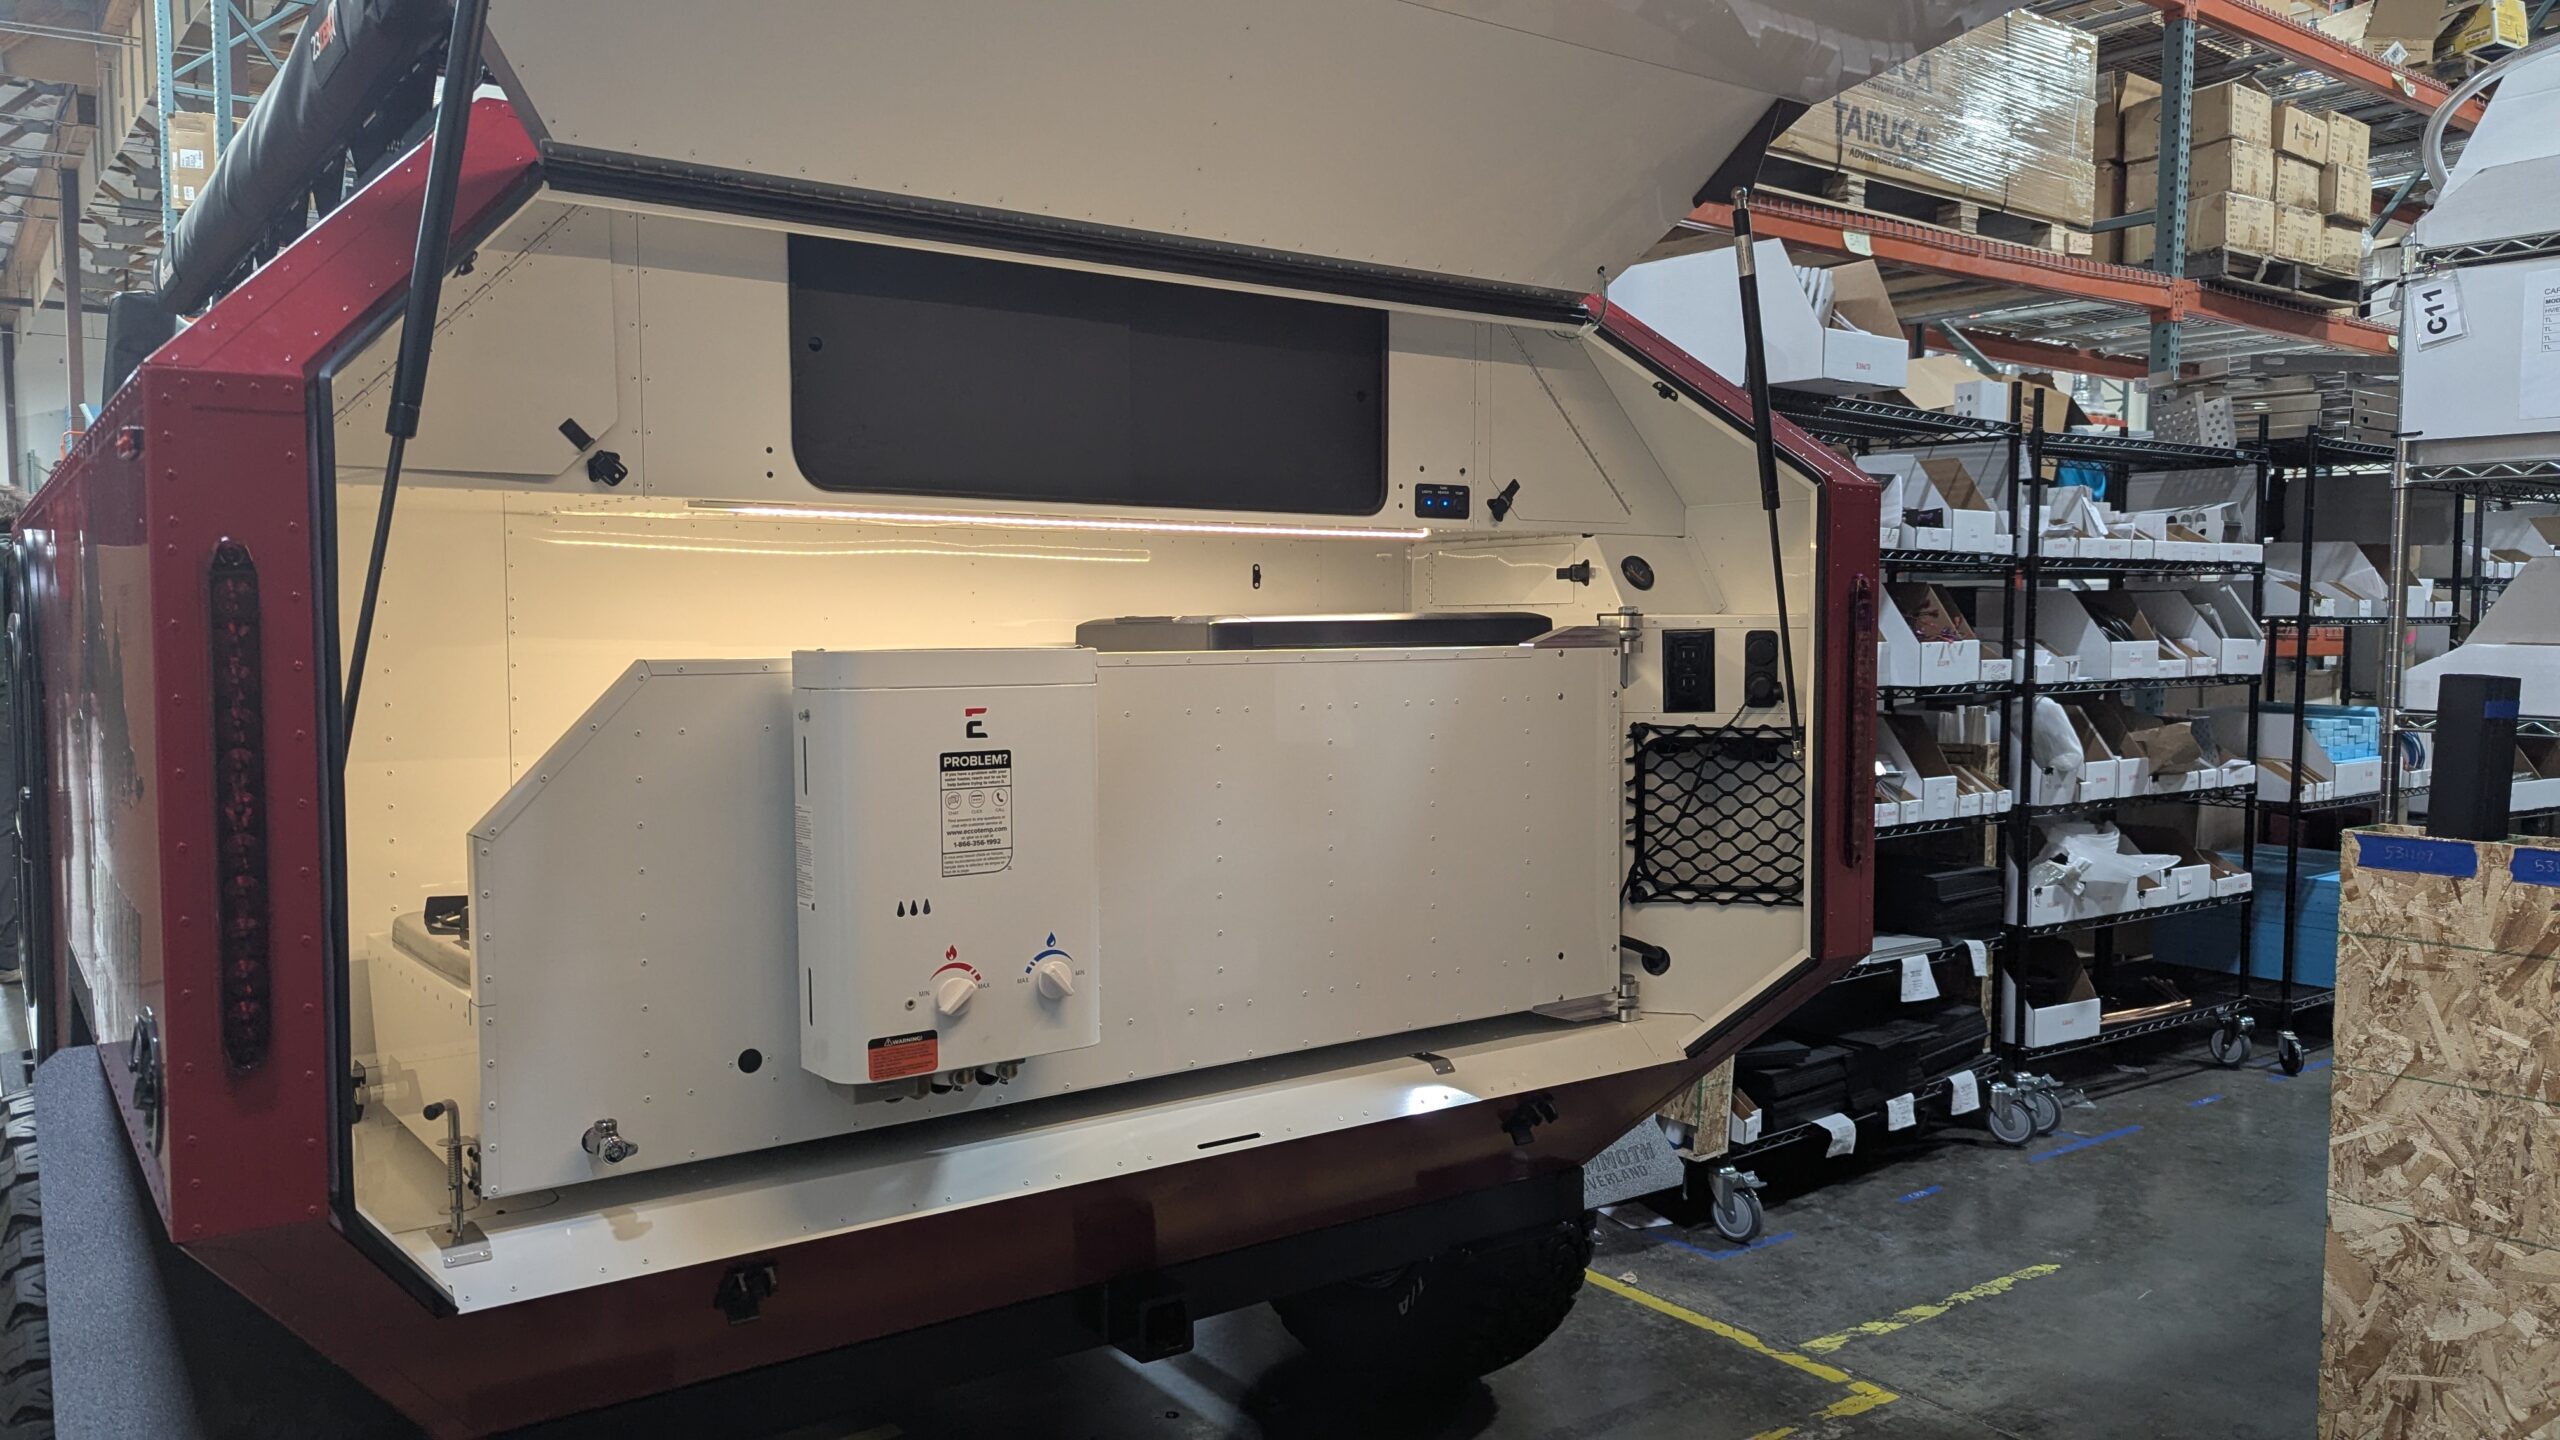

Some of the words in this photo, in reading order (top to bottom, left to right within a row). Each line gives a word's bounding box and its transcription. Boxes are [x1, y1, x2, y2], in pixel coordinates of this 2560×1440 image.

[1833, 100, 1930, 160] TARUCA
[1848, 147, 1893, 167] ADVENTURE
[2422, 288, 2448, 335] C11
[943, 754, 1008, 768] PROBLEM?
[946, 826, 1008, 836] www.eccotemp.com
[1016, 976, 1029, 984] MAX
[977, 982, 990, 990] MAX
[918, 990, 930, 998] MIN
[892, 1035, 923, 1046] WARNING!
